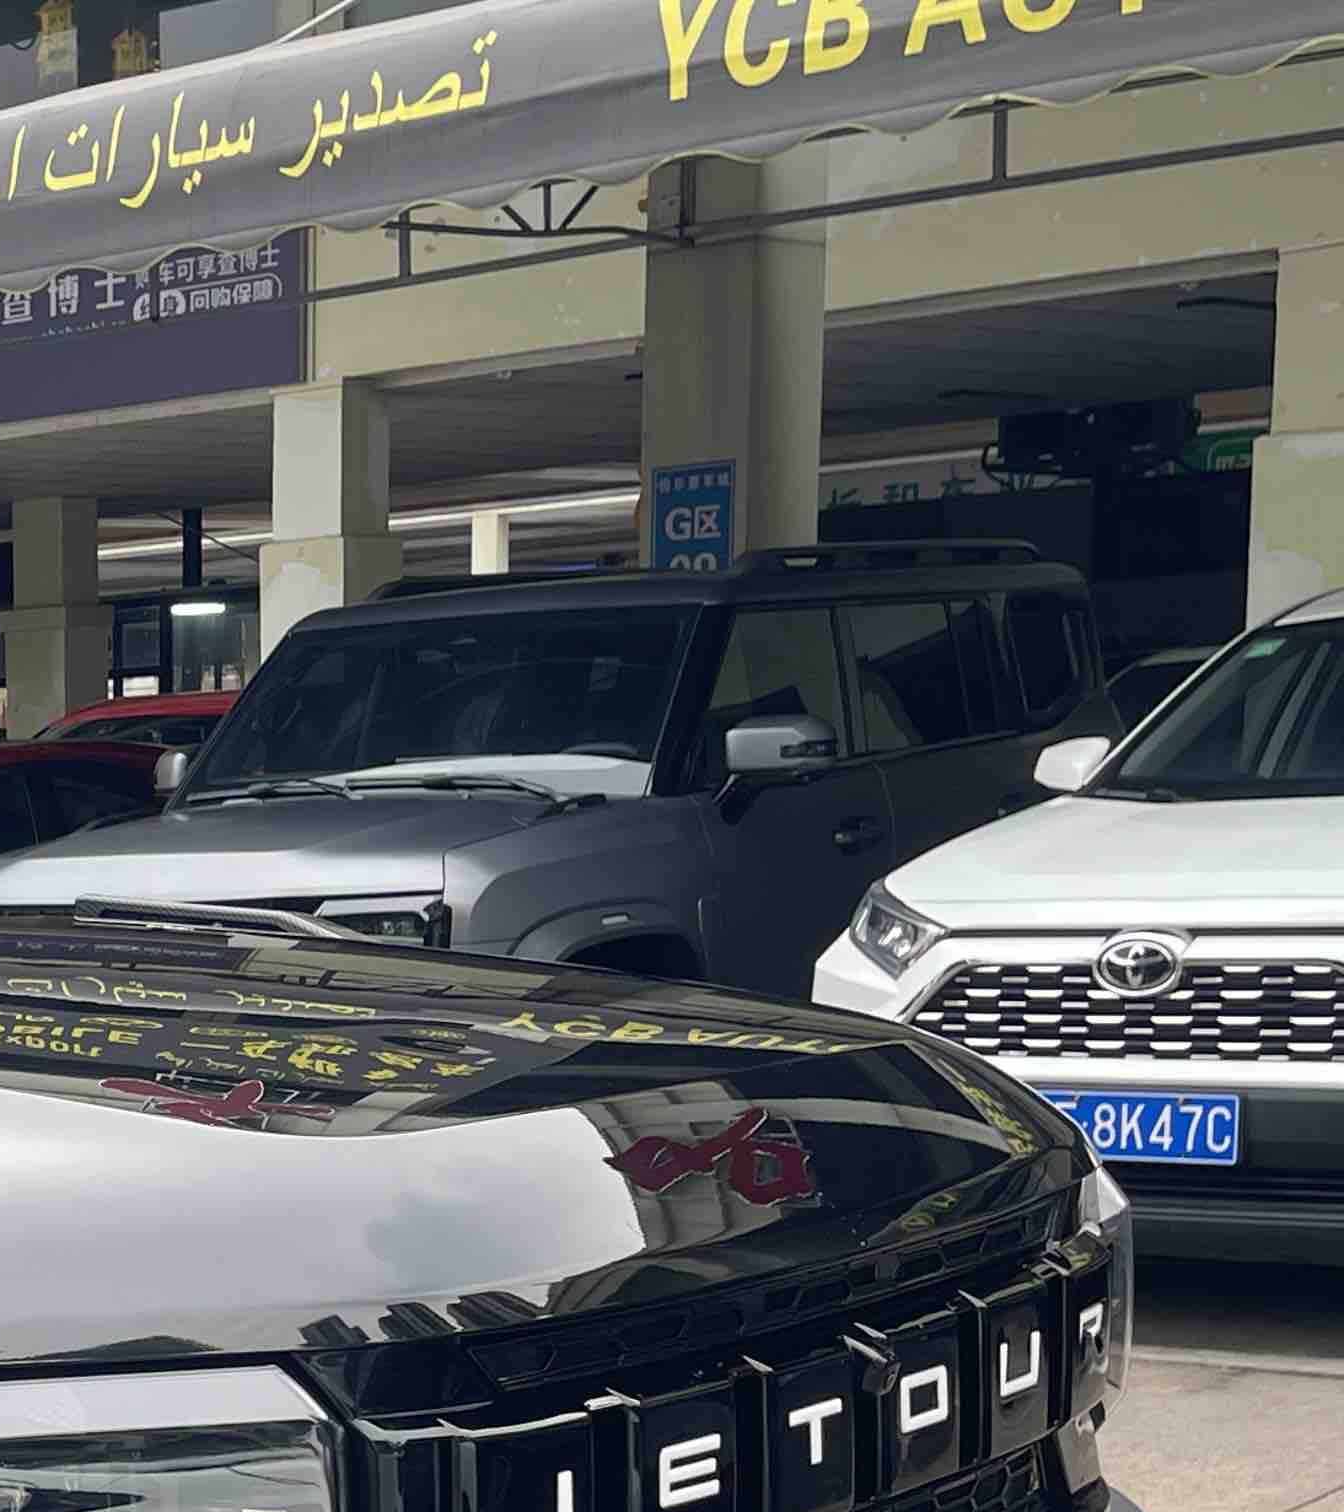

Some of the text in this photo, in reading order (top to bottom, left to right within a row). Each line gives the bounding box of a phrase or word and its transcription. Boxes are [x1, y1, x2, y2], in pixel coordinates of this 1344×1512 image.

[44, 91, 256, 209] سيارات
[281, 29, 498, 178] تصدير
[664, 504, 721, 542] G区
